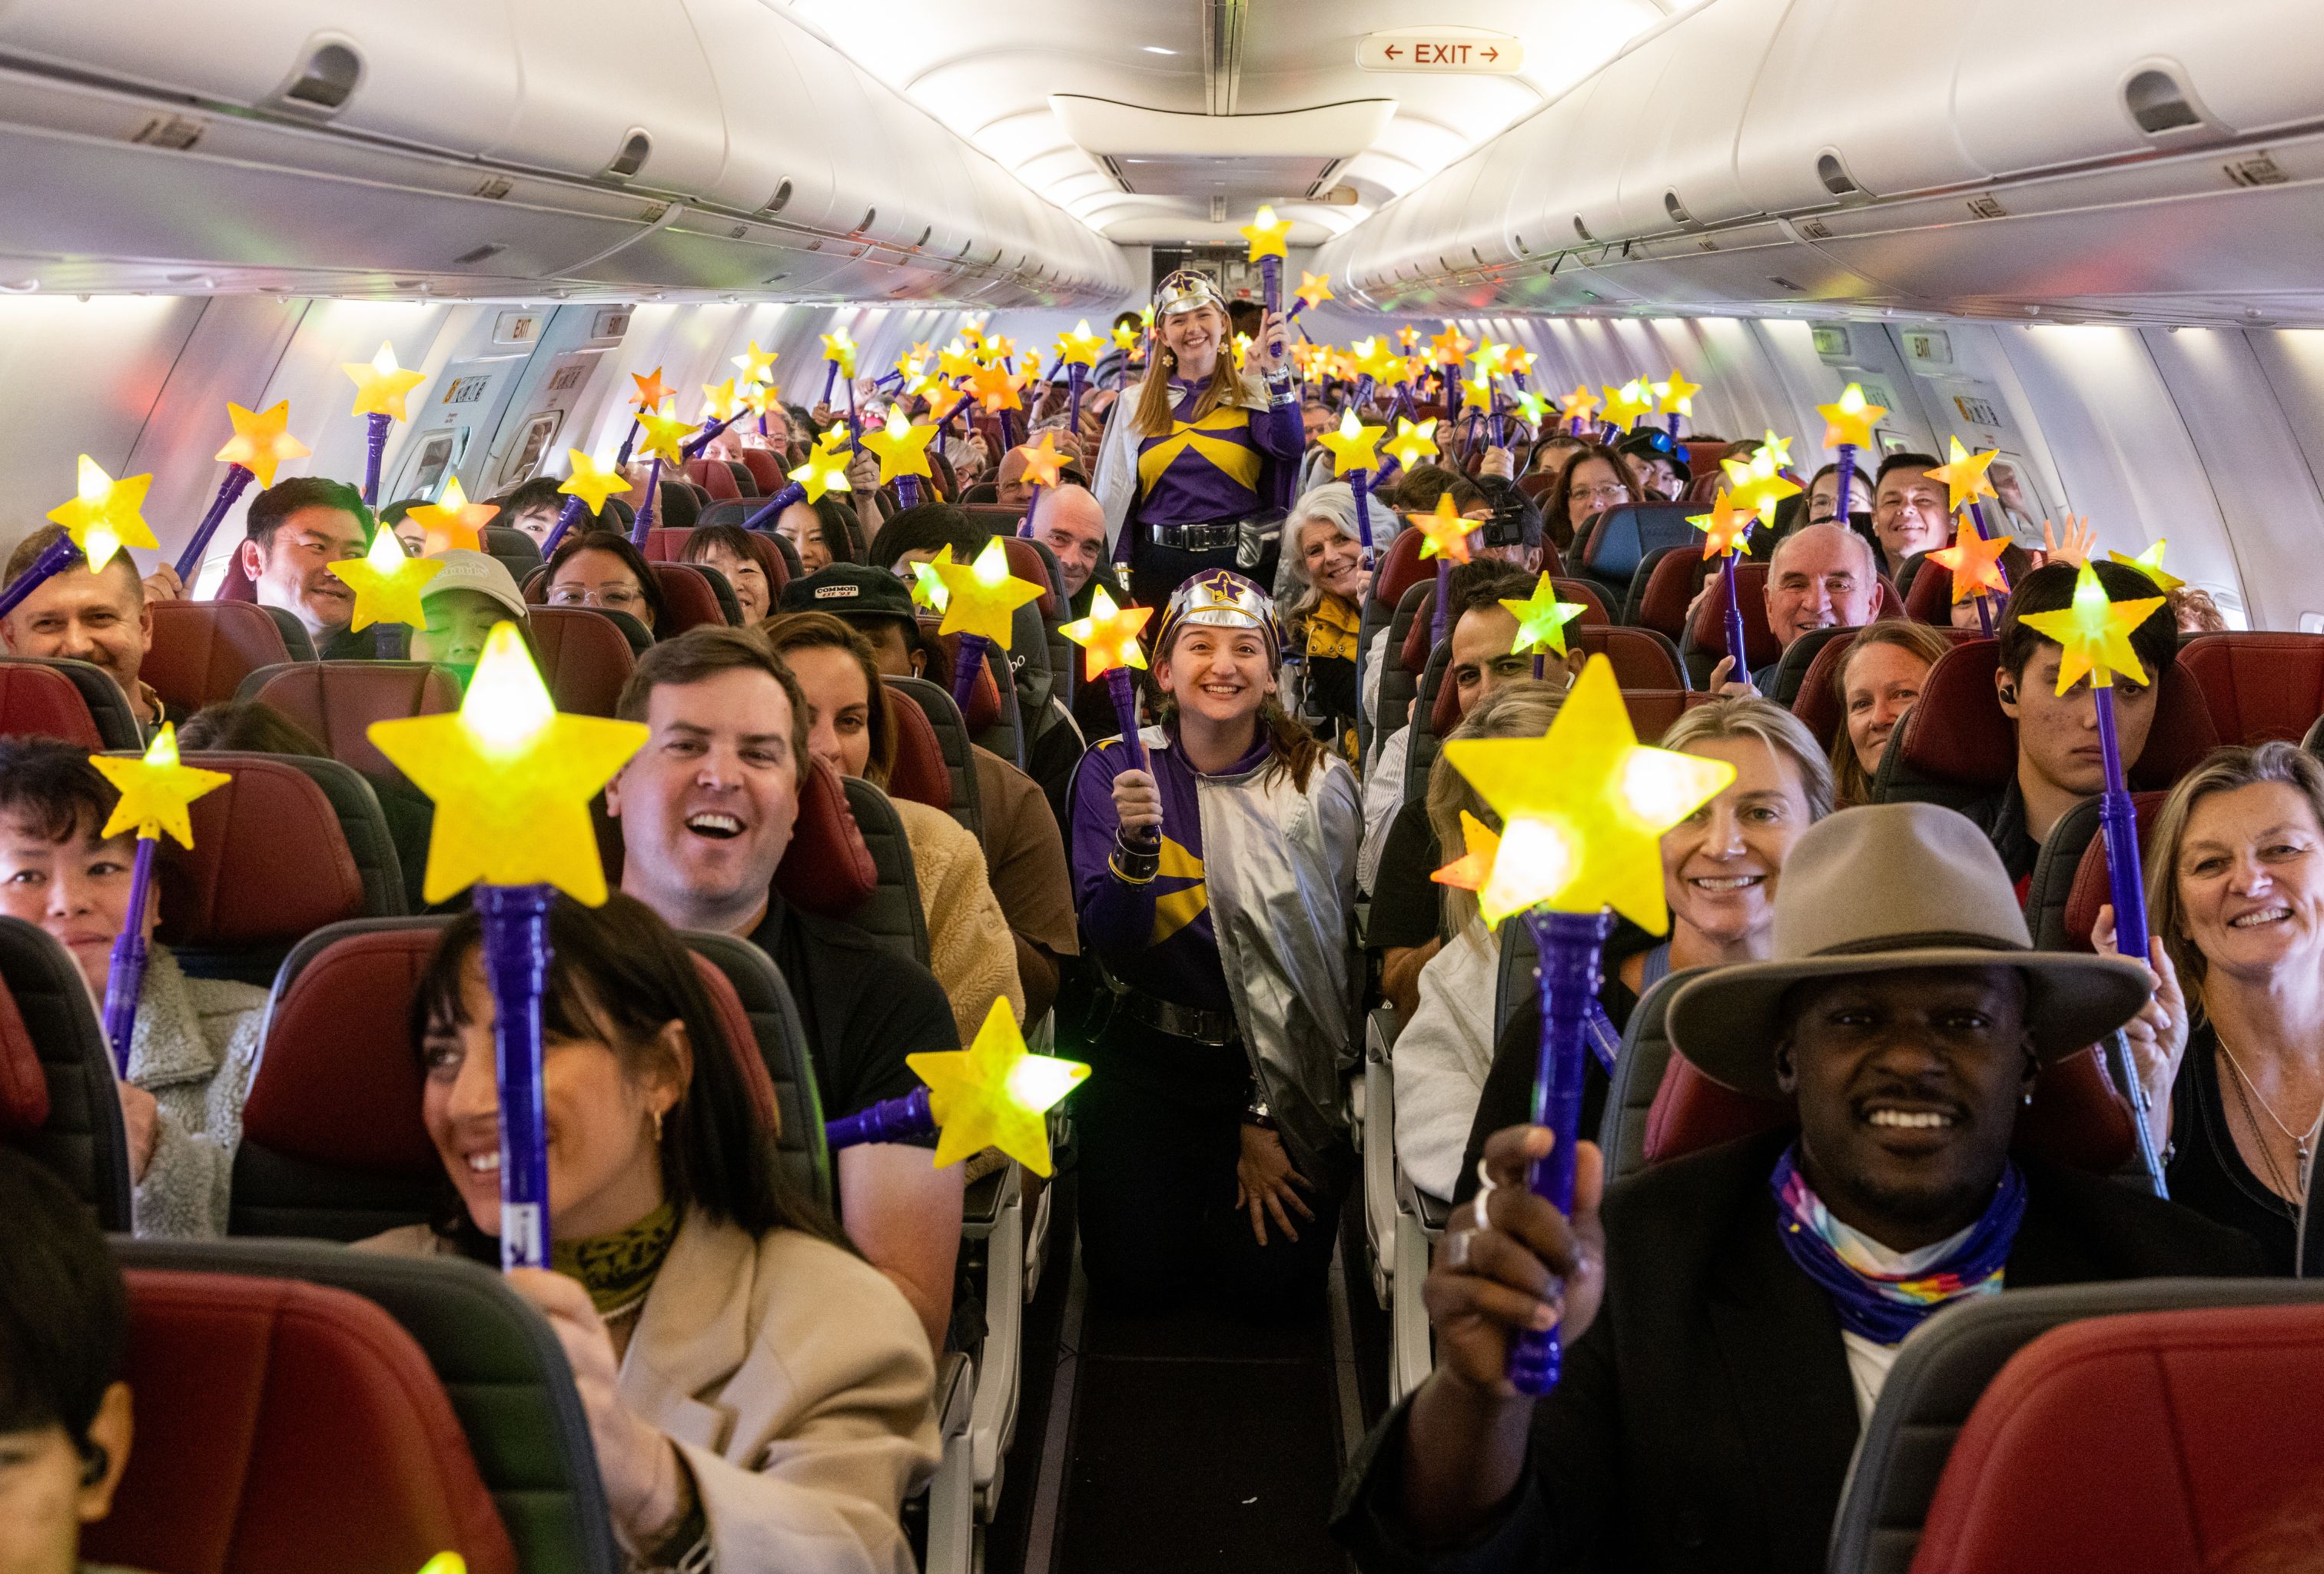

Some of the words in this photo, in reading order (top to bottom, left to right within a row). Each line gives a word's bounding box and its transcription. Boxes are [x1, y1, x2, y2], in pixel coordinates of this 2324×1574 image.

[1415, 44, 1472, 64] EXIT
[513, 318, 532, 339] EXIT
[607, 317, 622, 335] EXIT
[1914, 337, 1931, 358] EXIT
